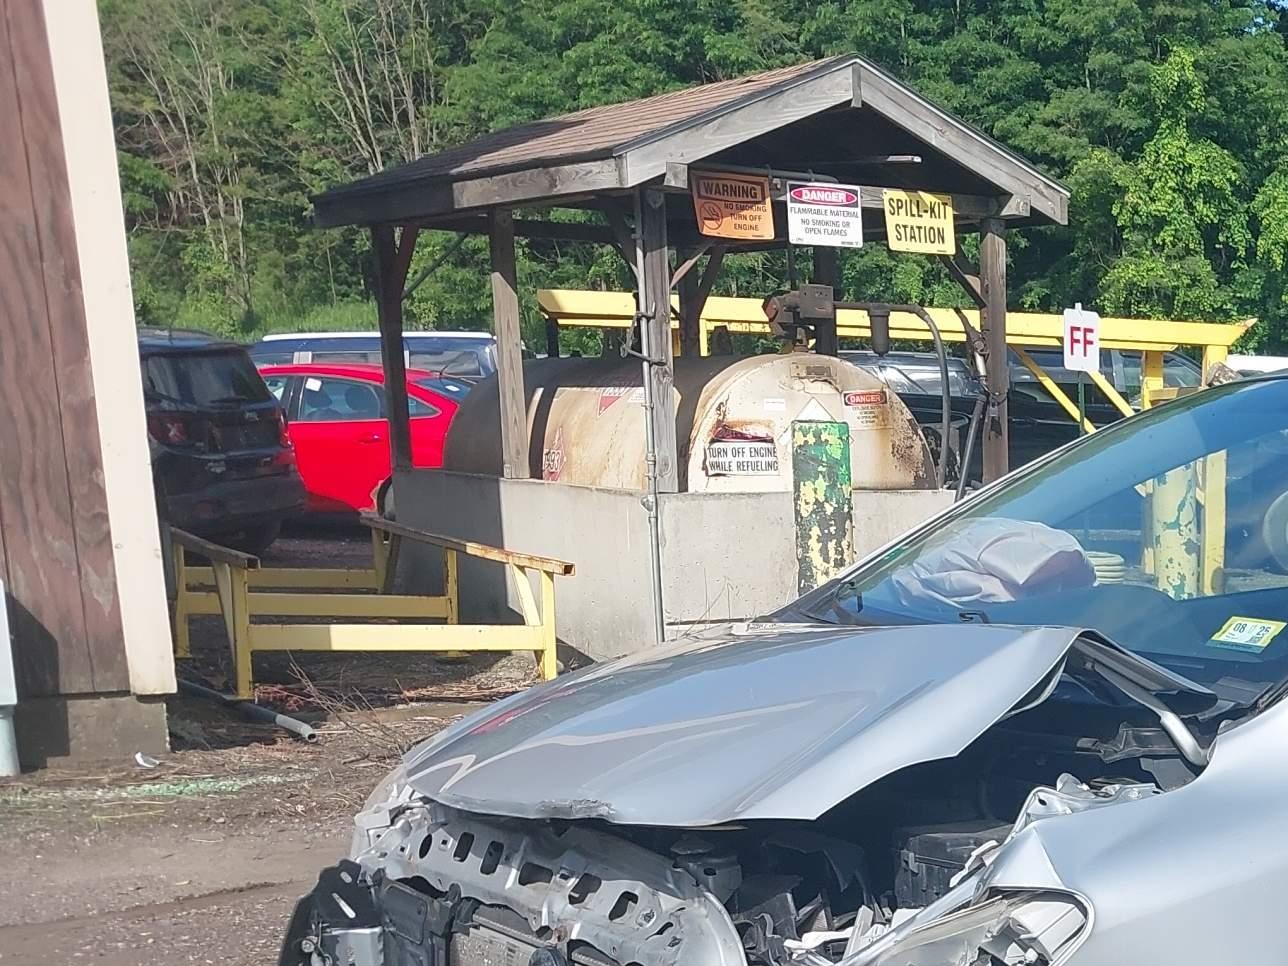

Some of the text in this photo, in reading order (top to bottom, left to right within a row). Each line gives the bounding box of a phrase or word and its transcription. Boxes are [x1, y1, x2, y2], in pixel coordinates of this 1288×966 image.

[703, 181, 758, 199] WARNING
[801, 189, 847, 203] DANGER
[735, 203, 767, 213] SMOKING
[789, 206, 859, 218] FLAMMABLE MATERIAL
[888, 197, 949, 220] SPILL-KIT
[749, 214, 763, 222] OFF
[800, 218, 810, 226] NO
[812, 219, 840, 228] SMOKING
[733, 223, 760, 231] ENGINE
[804, 227, 848, 236] OPEN FLAMES
[894, 223, 946, 245] STATION
[1070, 325, 1094, 358] FF
[850, 394, 881, 403] DANGER
[707, 446, 778, 458] TURN OFF ENGINE
[708, 460, 779, 472] WHILE REFUELING
[1233, 622, 1248, 634] 08
